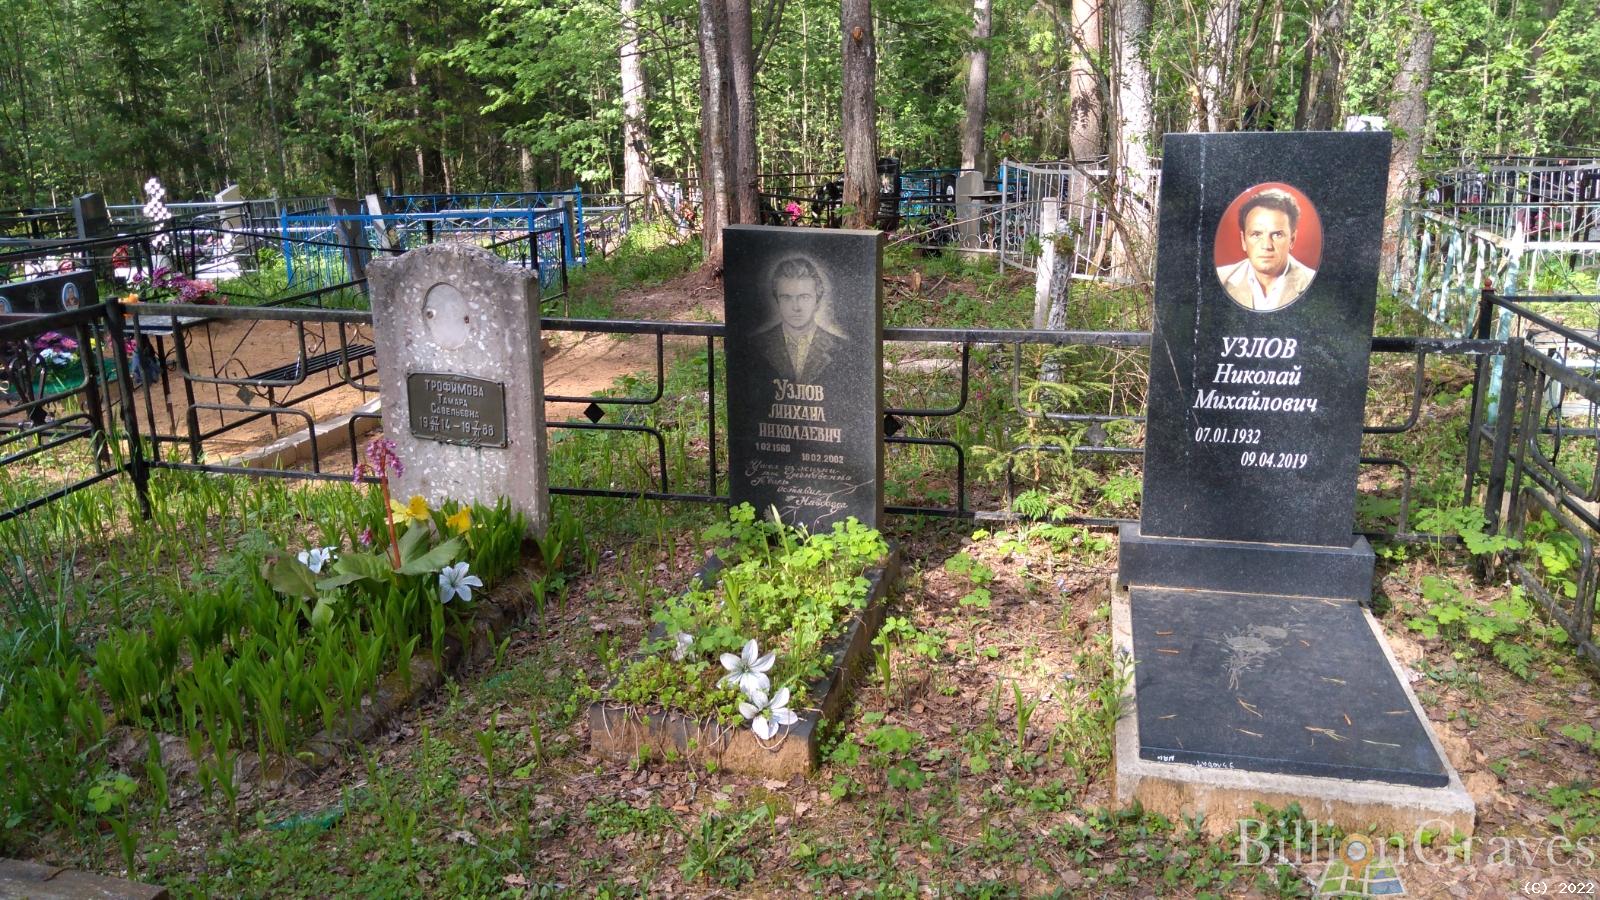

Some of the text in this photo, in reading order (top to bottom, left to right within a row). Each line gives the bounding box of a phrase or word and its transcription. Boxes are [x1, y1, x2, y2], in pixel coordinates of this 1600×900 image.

[1221, 337, 1298, 358] УЗЛОВ
[1213, 363, 1302, 386] Николай
[425, 379, 484, 397] ТРОФИМОВА
[1193, 389, 1318, 412] Михайлович
[768, 403, 826, 422] МИХАИЛ
[758, 422, 842, 443] НИКОЛАЕВИЧ
[1195, 427, 1261, 444] 07.01.1932
[1241, 451, 1308, 469] 09.04.2019
